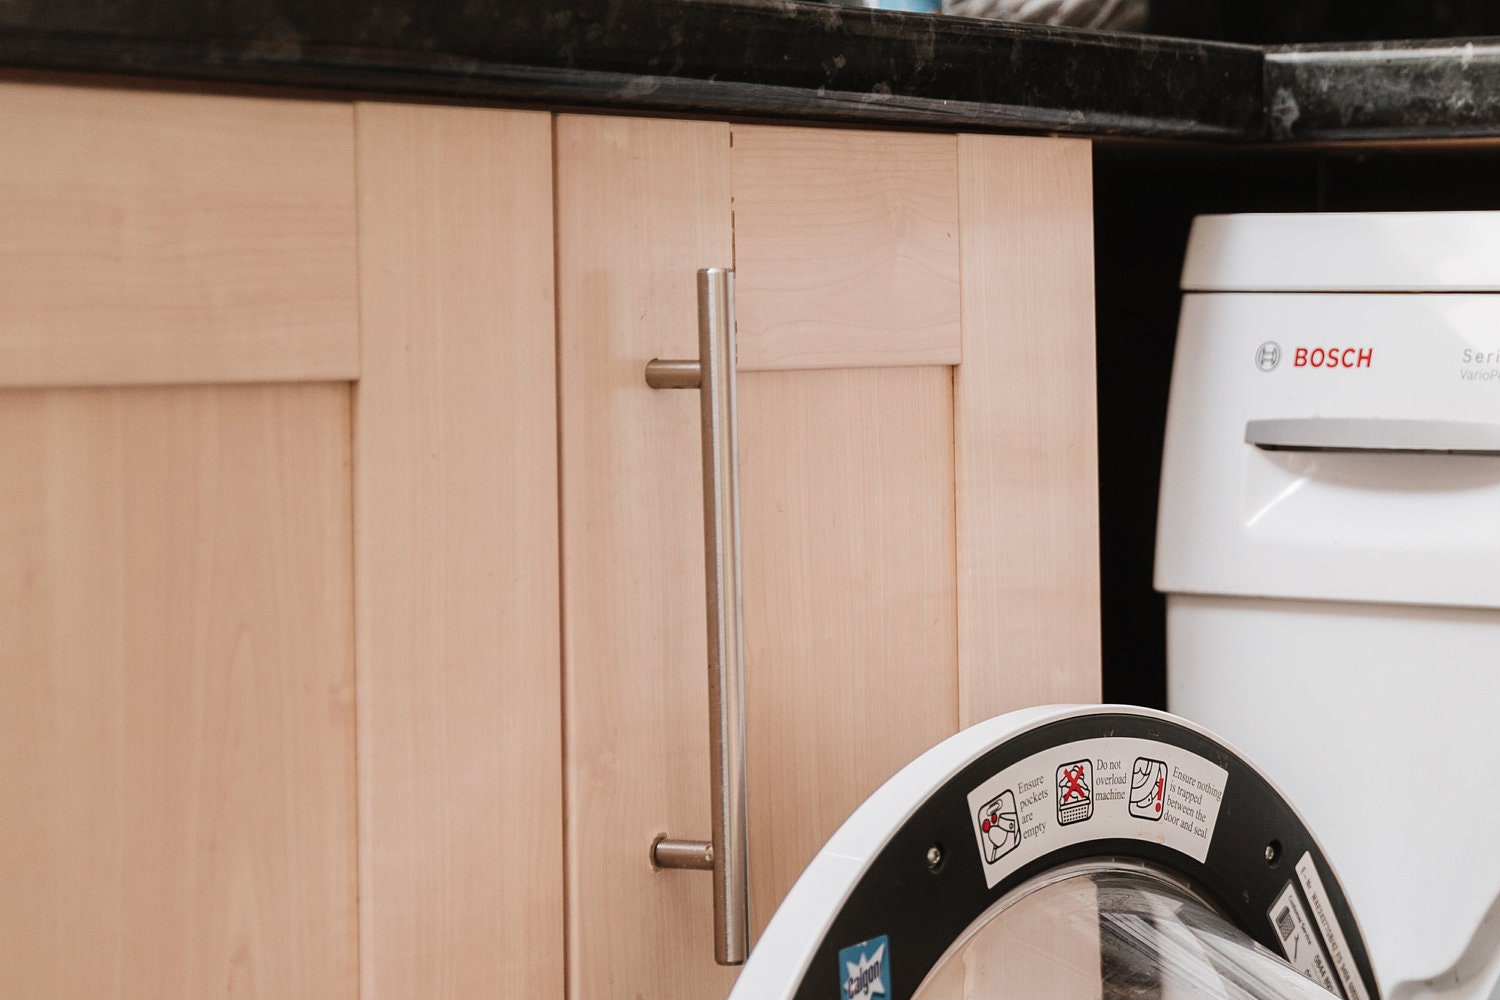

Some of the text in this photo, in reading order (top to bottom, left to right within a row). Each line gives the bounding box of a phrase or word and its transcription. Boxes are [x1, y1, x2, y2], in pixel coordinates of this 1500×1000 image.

[1293, 347, 1373, 369] BOSCH
[1096, 759, 1121, 770] Do not
[1017, 776, 1045, 794] Ensure
[1096, 774, 1127, 786] overload
[1172, 766, 1222, 802] Ensure nothing
[1020, 789, 1049, 812] pockets
[1095, 790, 1126, 801] machine
[1170, 780, 1203, 805] is trapped
[1021, 812, 1033, 825] are
[1166, 794, 1206, 823] between the
[1023, 821, 1047, 839] empty
[1163, 810, 1208, 839] door and seal
[847, 960, 880, 999] Calgon
